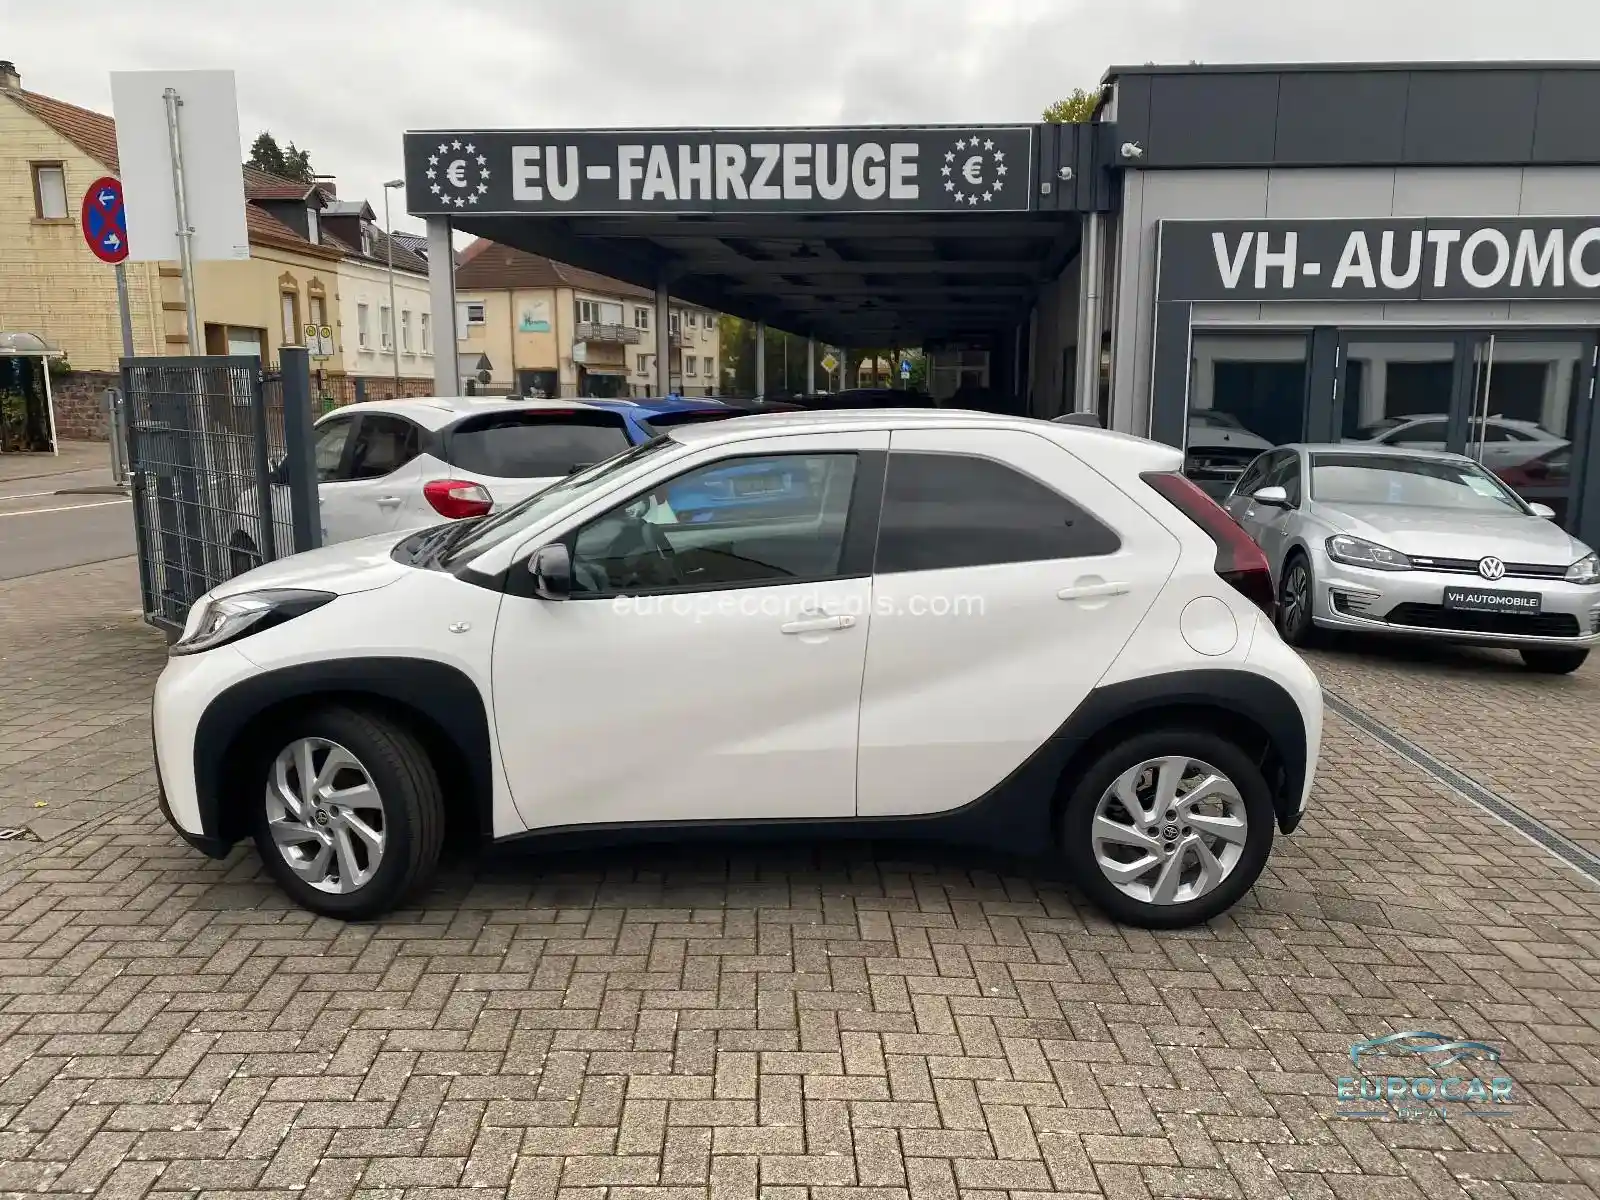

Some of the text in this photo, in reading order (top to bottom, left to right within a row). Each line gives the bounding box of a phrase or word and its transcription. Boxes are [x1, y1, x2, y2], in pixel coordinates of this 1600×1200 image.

[511, 142, 919, 201] EU-FAHRZEUGE
[1448, 592, 1537, 607] VH AUTOMOBILE
